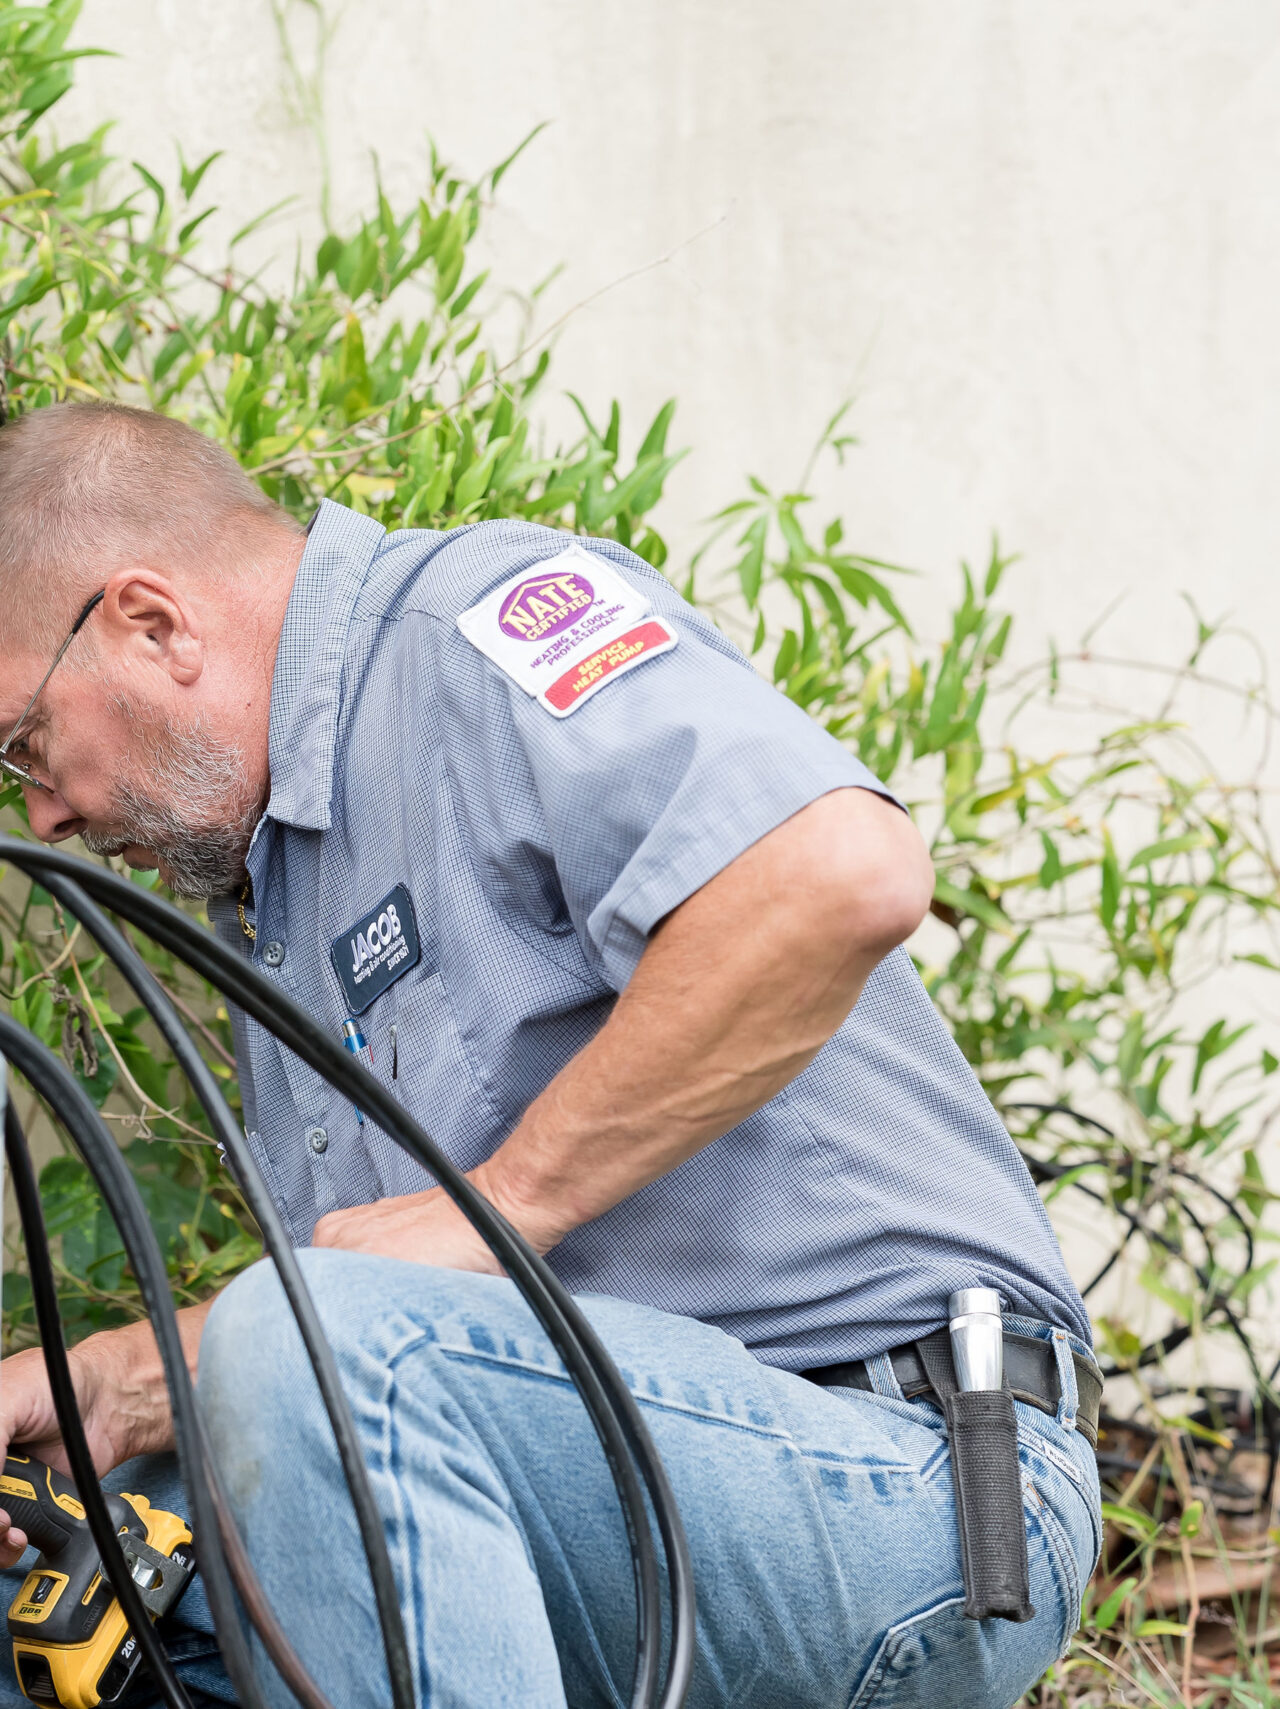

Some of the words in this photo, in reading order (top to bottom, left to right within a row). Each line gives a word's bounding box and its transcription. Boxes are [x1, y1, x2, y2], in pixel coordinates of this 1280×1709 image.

[503, 574, 585, 634] NATE
[525, 594, 592, 640] CERTIFIED
[530, 636, 570, 668] HEATING
[570, 618, 580, 635] &
[580, 604, 624, 628] COOLING
[547, 616, 618, 665] PROFESSIONAL
[578, 641, 626, 675] SERVICE
[572, 665, 603, 692] HEAT
[608, 641, 644, 666] PUMP
[351, 904, 401, 973] JACOB
